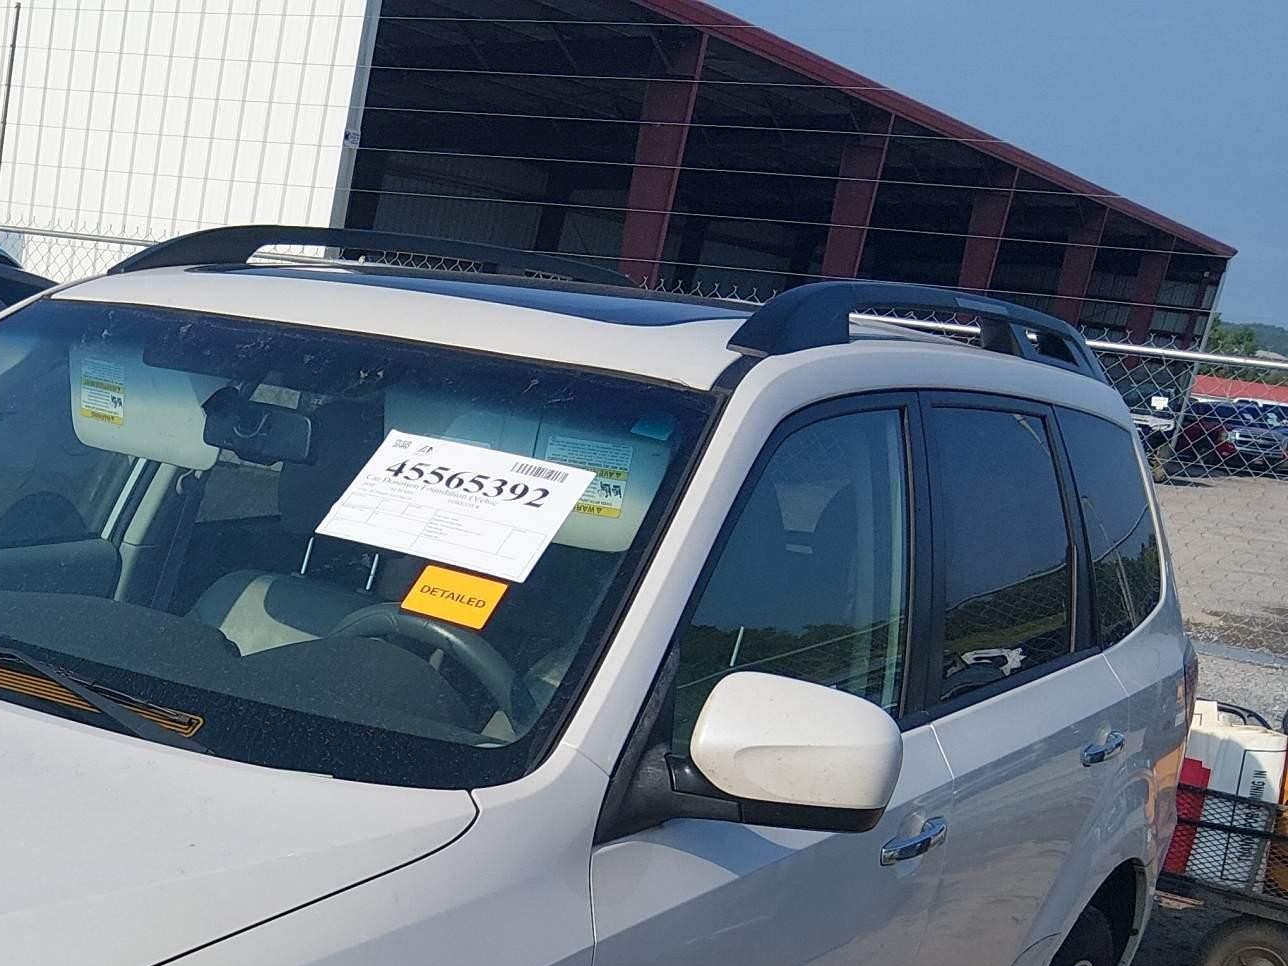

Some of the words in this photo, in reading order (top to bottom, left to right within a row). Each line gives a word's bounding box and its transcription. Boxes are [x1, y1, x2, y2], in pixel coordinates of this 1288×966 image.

[384, 459, 551, 508] 45565392
[419, 584, 487, 609] DETAILED
[1253, 769, 1268, 779] IN
